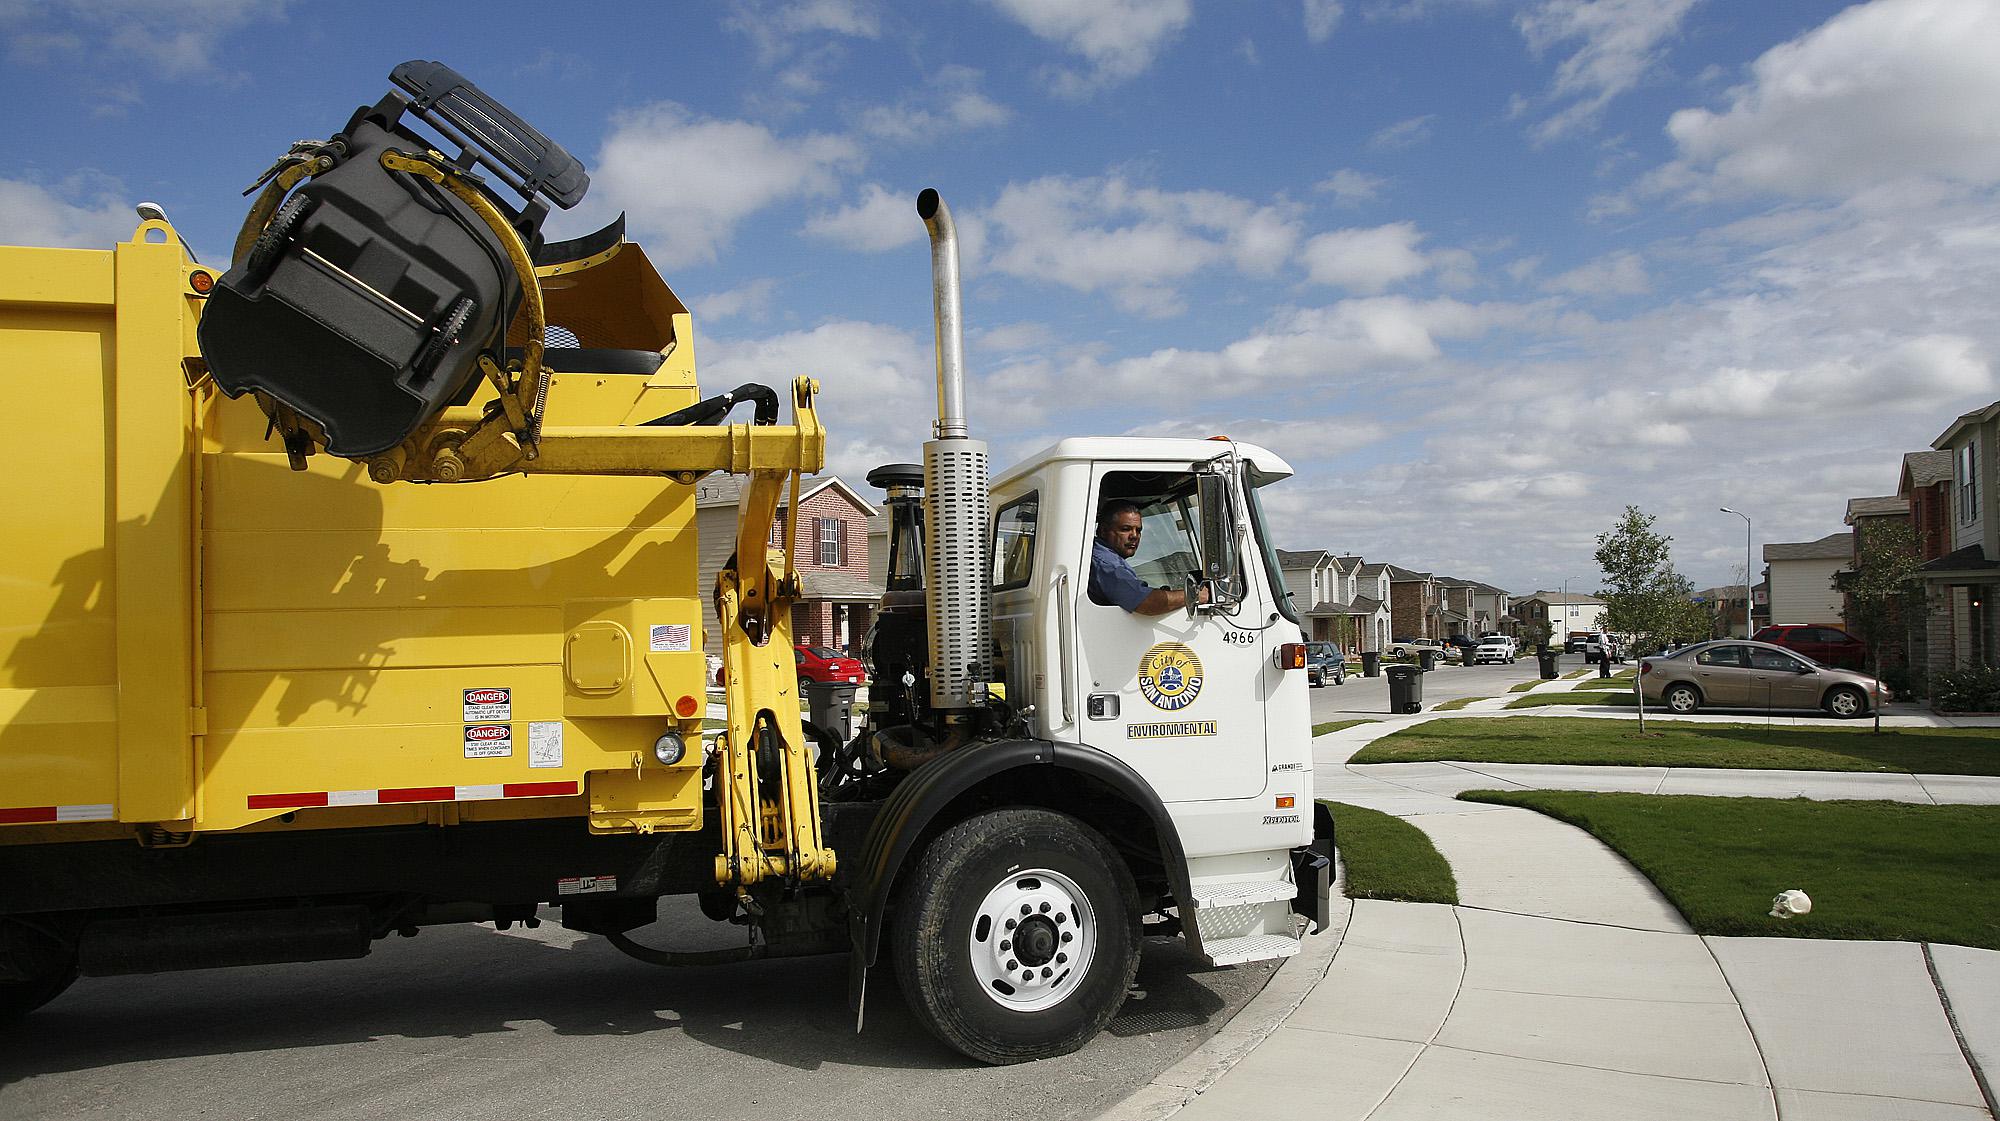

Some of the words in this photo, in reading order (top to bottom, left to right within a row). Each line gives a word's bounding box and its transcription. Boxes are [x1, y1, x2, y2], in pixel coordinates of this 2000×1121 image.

[1222, 631, 1254, 644] 4966
[1152, 655, 1175, 670] City
[1175, 660, 1191, 670] of
[470, 693, 505, 701] DANGER
[1141, 677, 1160, 702] SAN
[1155, 678, 1201, 710] ANTONIO
[470, 729, 505, 738] DANGER
[1128, 722, 1216, 738] ENVIRONMENTAL
[1262, 815, 1300, 825] XPEDITOR
